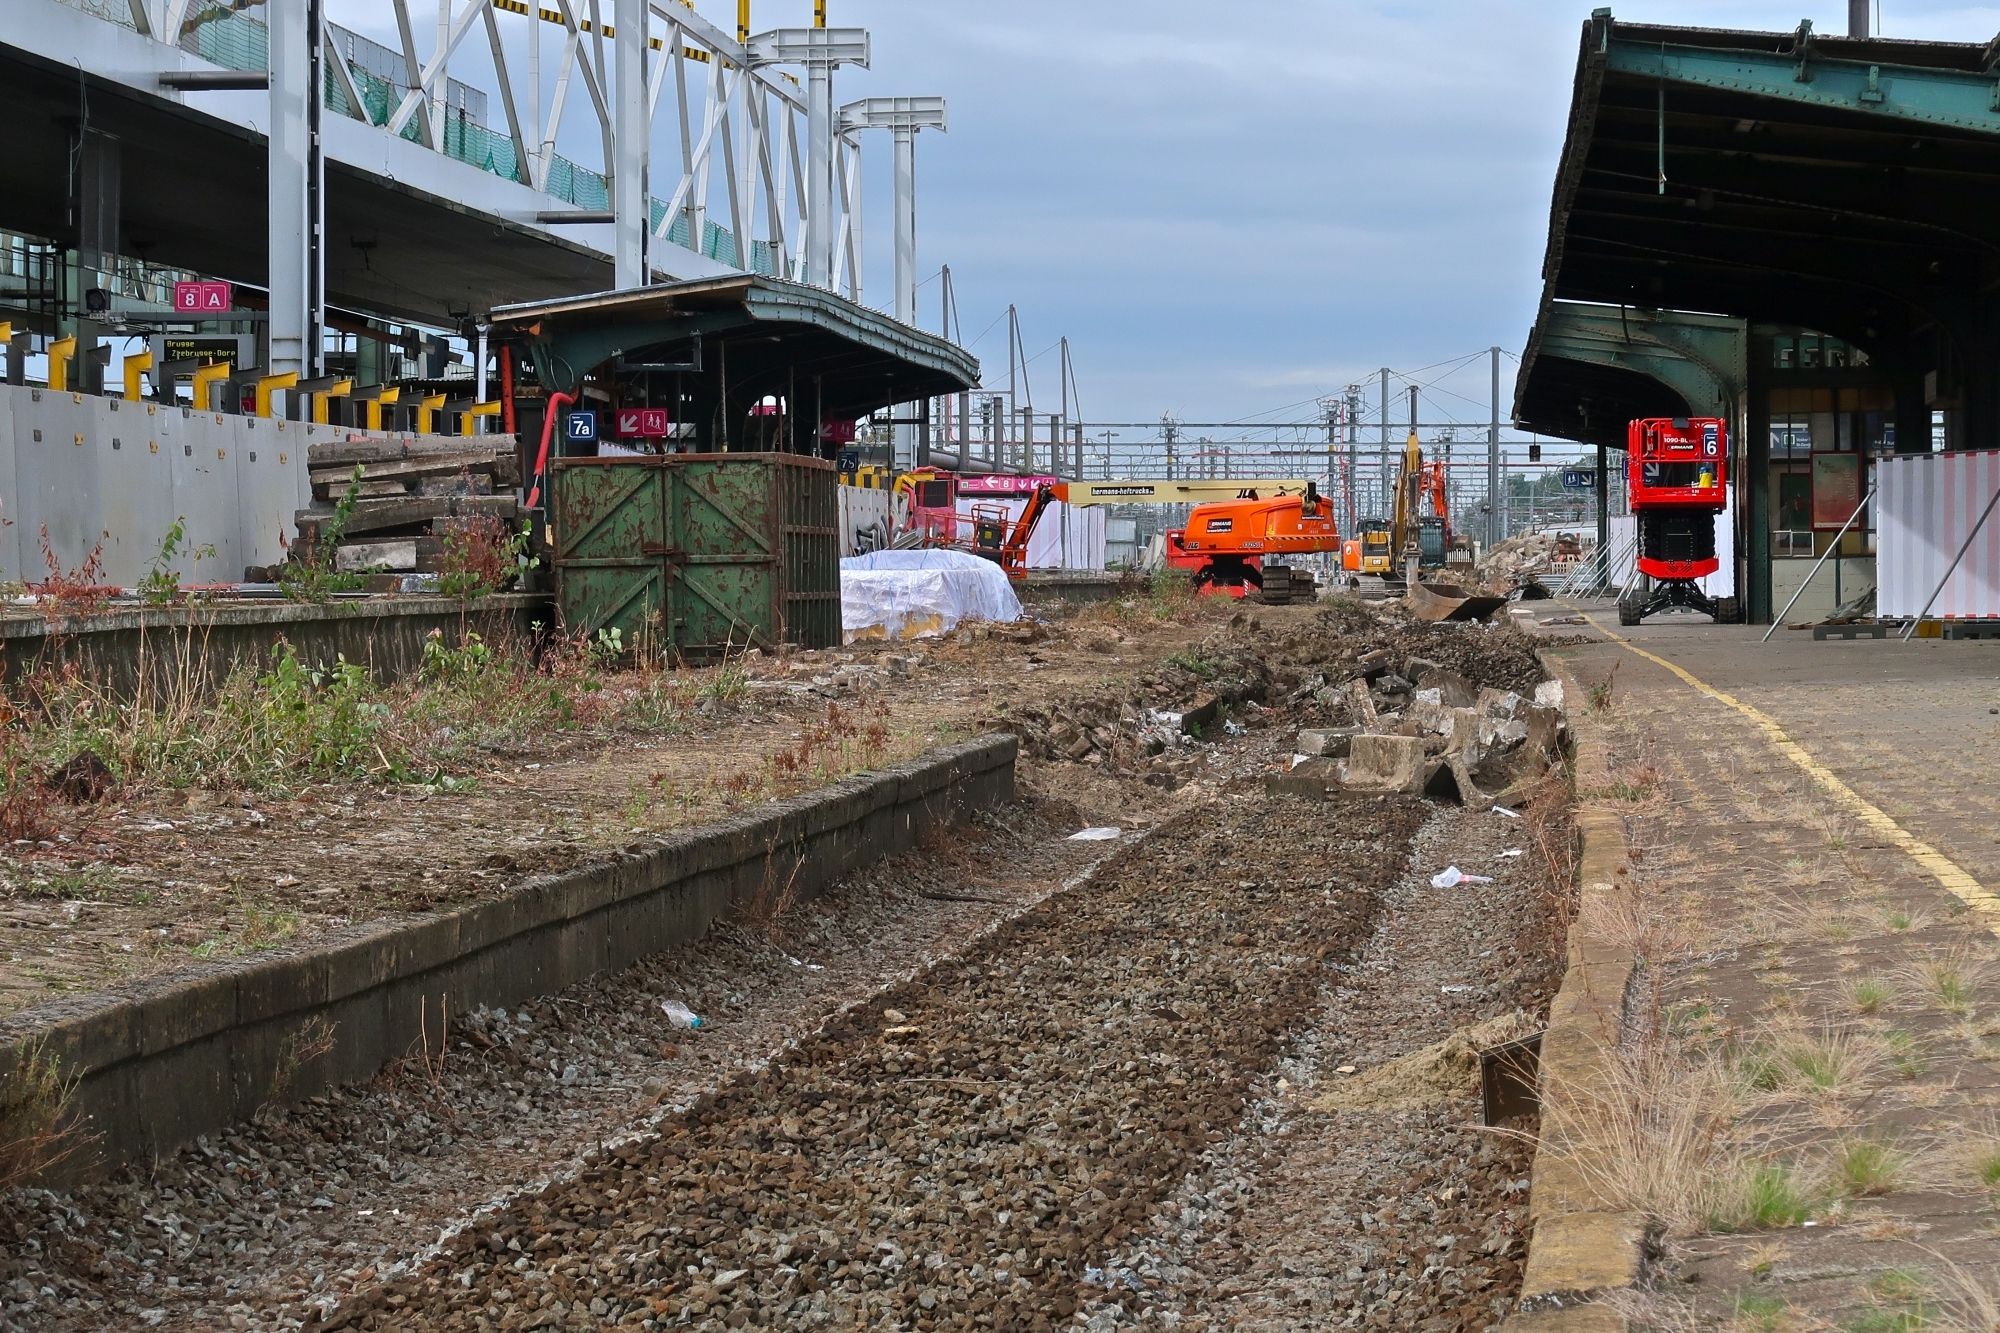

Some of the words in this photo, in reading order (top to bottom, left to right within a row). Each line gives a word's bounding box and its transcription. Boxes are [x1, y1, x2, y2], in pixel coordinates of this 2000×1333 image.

[185, 293, 195, 306] 8
[209, 292, 220, 306] A
[167, 340, 195, 348] Brugge
[573, 420, 590, 435] 7a
[1706, 440, 1717, 455] 6
[1003, 480, 1009, 488] 8
